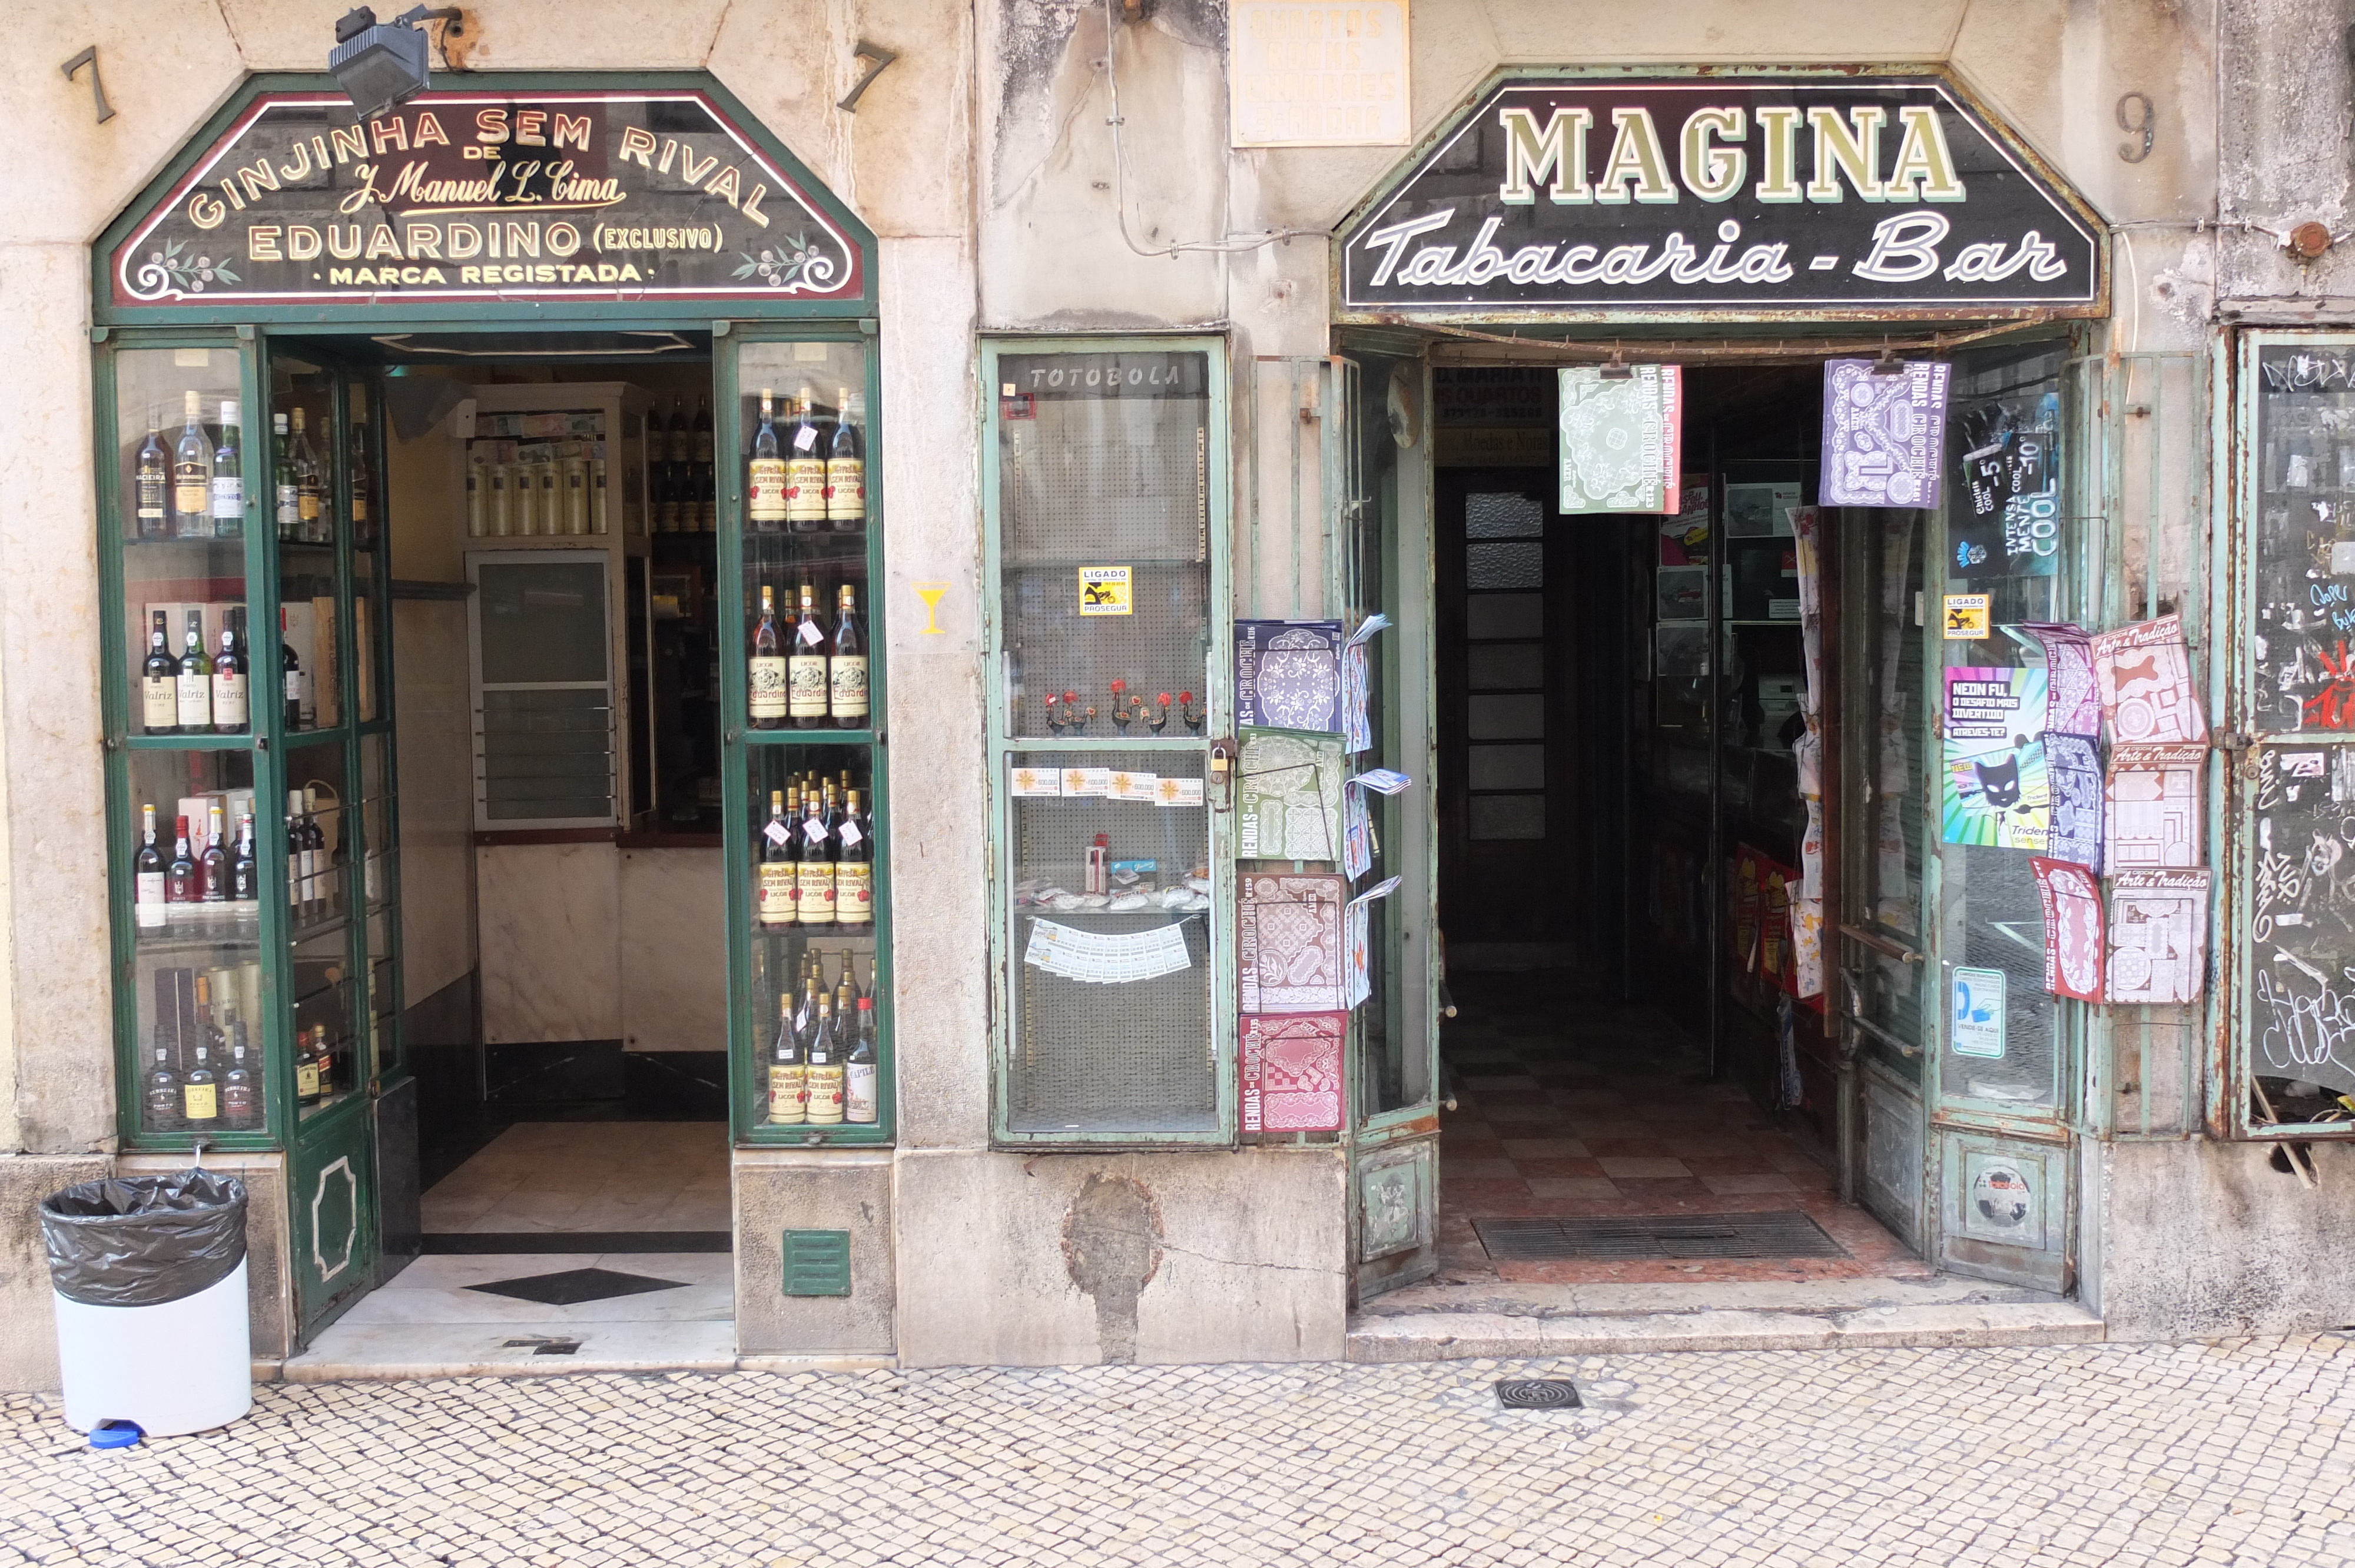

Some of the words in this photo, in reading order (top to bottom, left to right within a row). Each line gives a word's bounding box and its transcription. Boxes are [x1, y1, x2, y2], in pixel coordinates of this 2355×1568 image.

[1251, 9, 1382, 39] QUARTOS
[1267, 42, 1361, 70] ROOMS
[61, 45, 116, 124] 7
[837, 39, 896, 113] 7
[1245, 72, 1396, 102] CHAMBRES
[1289, 106, 1381, 135] ANDAR
[2116, 91, 2155, 164] 9
[189, 112, 450, 229] GINJINHA
[476, 109, 592, 152] SEM
[619, 126, 770, 228] RIVAL
[463, 147, 501, 161] DE
[1500, 106, 1966, 204] MAGINA
[378, 161, 507, 204] Manuel
[248, 222, 582, 261] EDUARDINO
[593, 222, 724, 253] (EXCLUSIVO)
[1364, 208, 1793, 286] Tabacaria
[1852, 210, 2067, 282] Bar
[329, 267, 447, 285] MARCA
[461, 264, 642, 284] REGISTADA
[1031, 366, 1179, 387] TOTOBOLA
[1640, 367, 1658, 410] RENDAS
[1912, 364, 1929, 407] RENDAS
[2012, 466, 2022, 493] COOL
[1982, 486, 1994, 512] COOL
[2005, 495, 2018, 556] INTENSA
[2016, 494, 2031, 552] MENTE
[2031, 478, 2057, 556] COOL
[2096, 638, 2122, 657] Arte
[2129, 623, 2177, 645] Tradição
[145, 691, 172, 700] Valriz
[216, 690, 244, 699] Valriz
[1953, 683, 1986, 696] NEON
[1960, 697, 1995, 707] DESAFIO
[1996, 699, 2018, 708] MAIS
[1952, 709, 2004, 719] DIVERTIDO
[1953, 727, 2005, 736] ATREVES-TE?
[2113, 748, 2142, 762] Arte
[2153, 747, 2201, 763] Tradição
[1242, 813, 1258, 859] RENDAS
[2012, 825, 2048, 836] Triden
[2115, 871, 2145, 886] Arte
[2154, 871, 2207, 890] Tradição
[1242, 966, 1258, 1011] RENDAS
[1245, 1089, 1261, 1131] RENDAS
